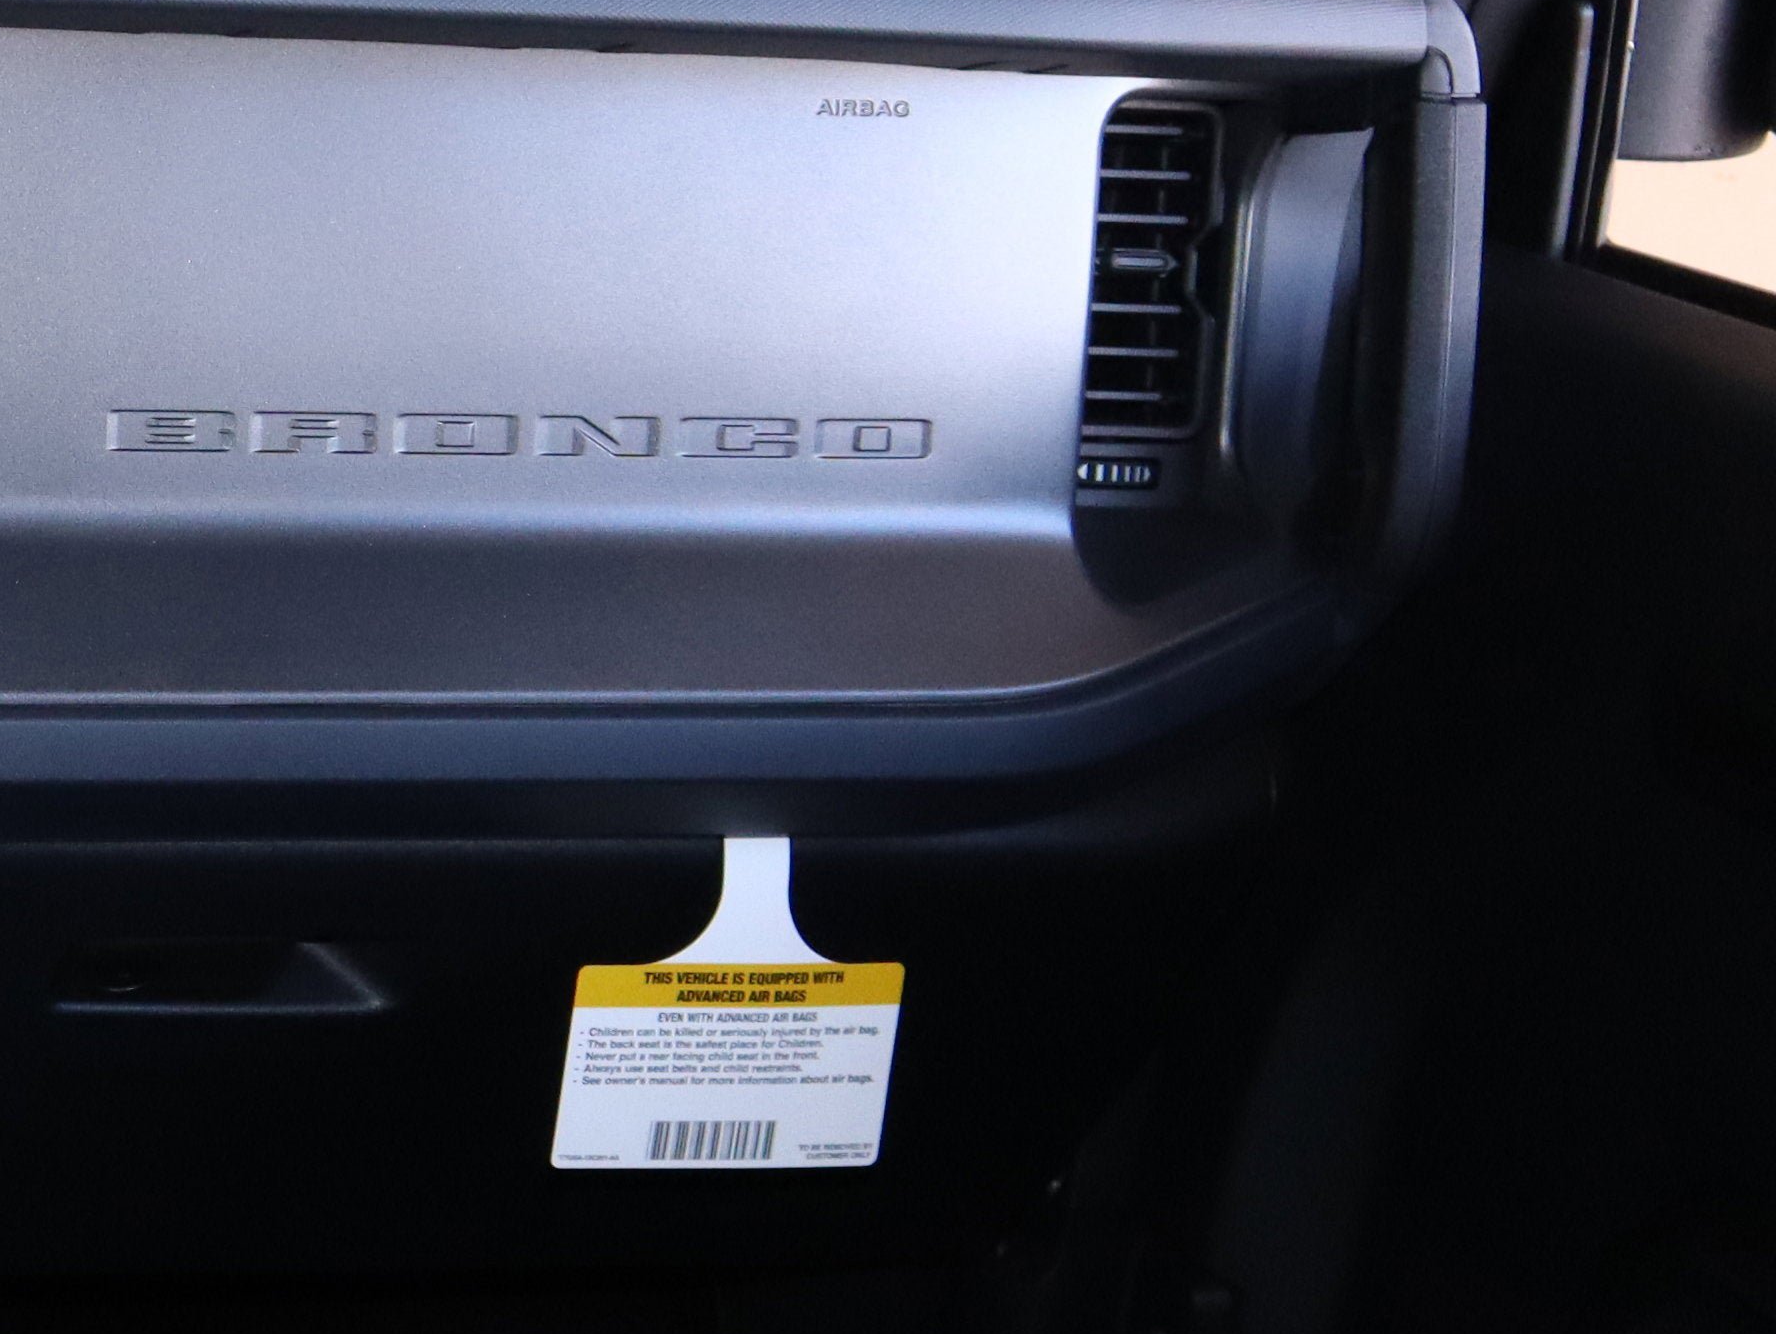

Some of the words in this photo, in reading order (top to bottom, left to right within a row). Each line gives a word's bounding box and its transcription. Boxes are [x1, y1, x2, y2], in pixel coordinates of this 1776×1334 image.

[815, 98, 910, 118] AIRBAG
[106, 409, 933, 460] BRONCO
[644, 972, 672, 985] THIS
[676, 972, 729, 985] VEHICLE
[732, 972, 745, 985] IS
[749, 972, 809, 985] EQUIPPED
[813, 971, 844, 984] WITH
[676, 990, 745, 1003] ADVANCED
[748, 990, 770, 1003] AIR
[774, 990, 807, 1003] BAGS
[657, 1012, 683, 1023] EVEN
[687, 1012, 714, 1023] WITH
[716, 1012, 770, 1023] ADVANCED
[771, 1012, 789, 1023] AIR
[792, 1011, 818, 1022] BAGS
